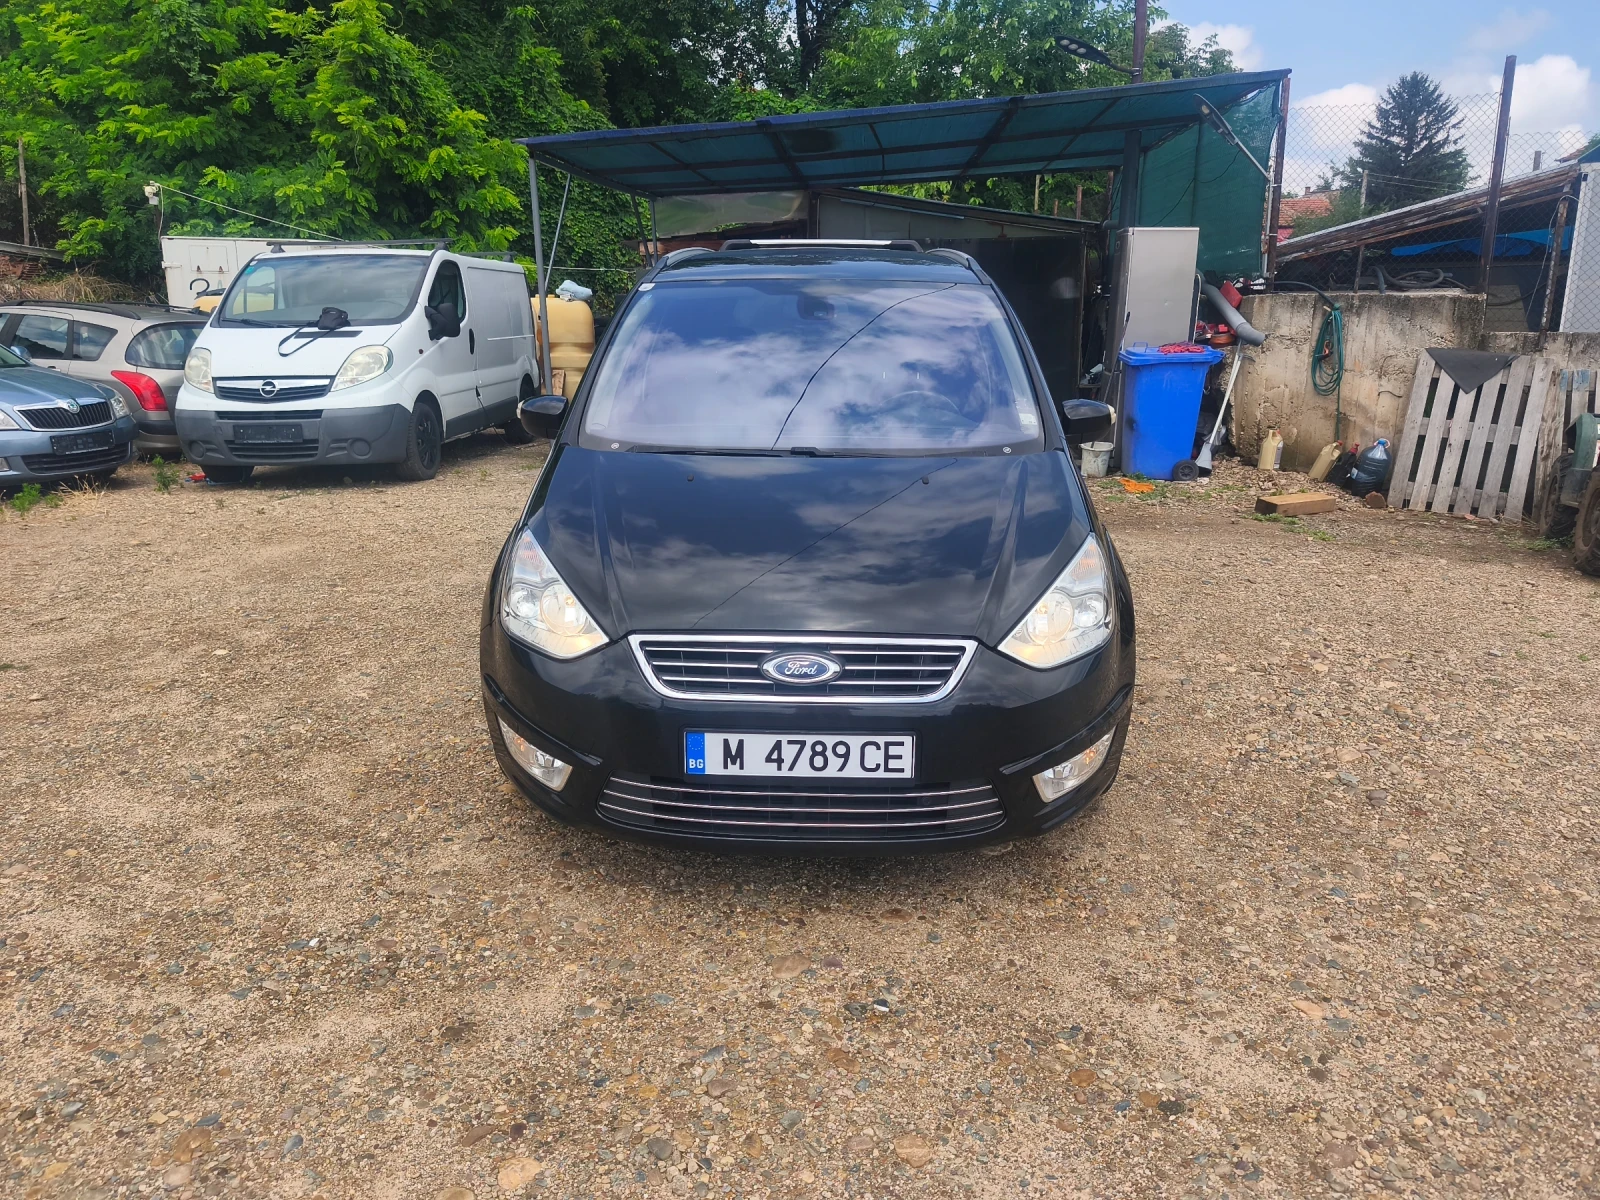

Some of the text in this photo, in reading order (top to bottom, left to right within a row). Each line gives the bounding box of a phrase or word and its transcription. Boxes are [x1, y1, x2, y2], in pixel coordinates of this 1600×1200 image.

[784, 661, 818, 675] Ford
[722, 738, 745, 770] M
[689, 758, 704, 769] BG
